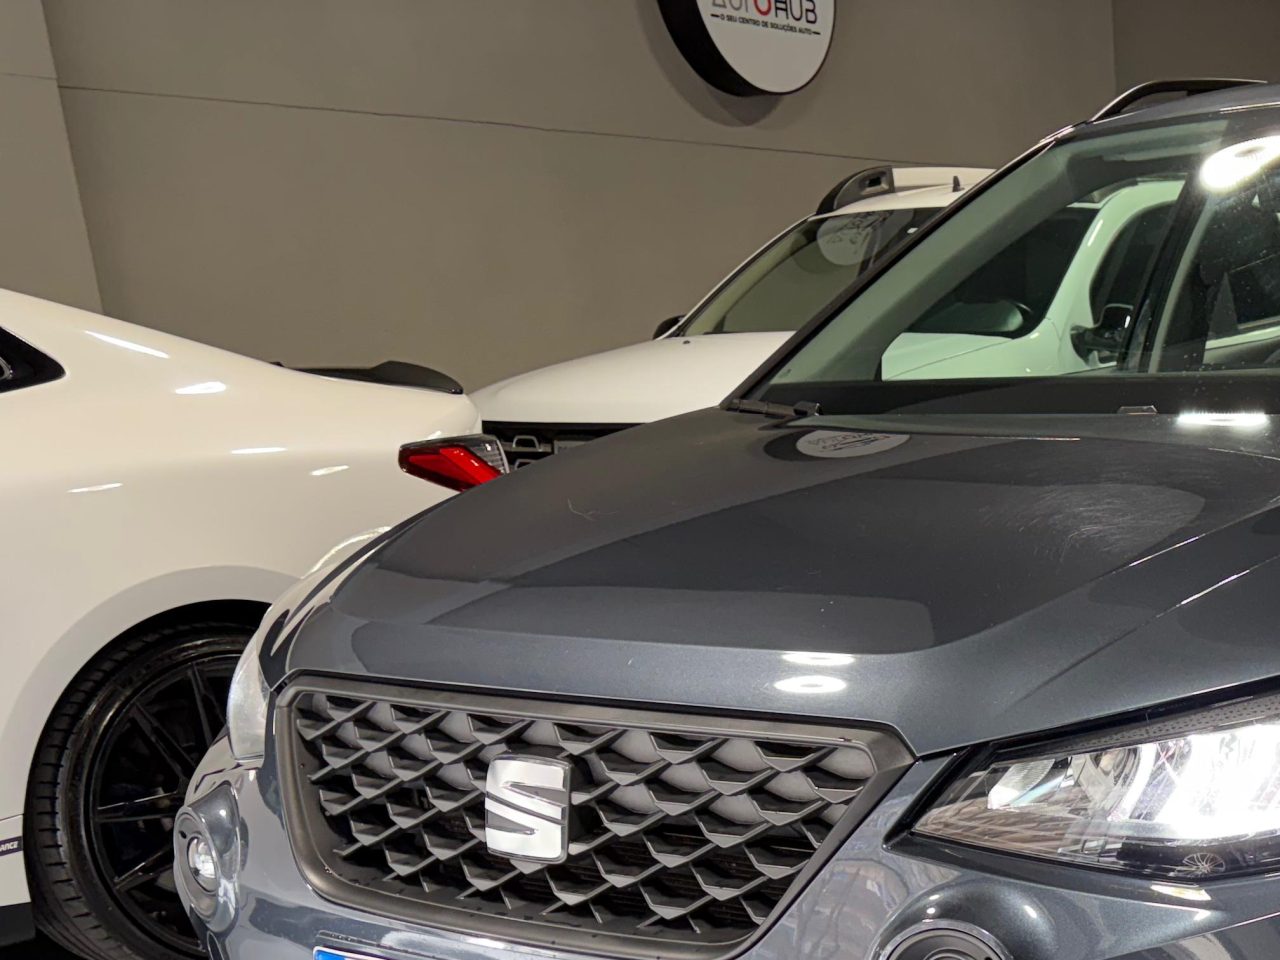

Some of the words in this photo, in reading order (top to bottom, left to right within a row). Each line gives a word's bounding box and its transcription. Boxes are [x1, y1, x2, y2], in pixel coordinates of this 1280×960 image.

[739, 17, 760, 26] CENTRO
[770, 22, 797, 33] SOLUÇÕES
[798, 27, 812, 35] AUTO
